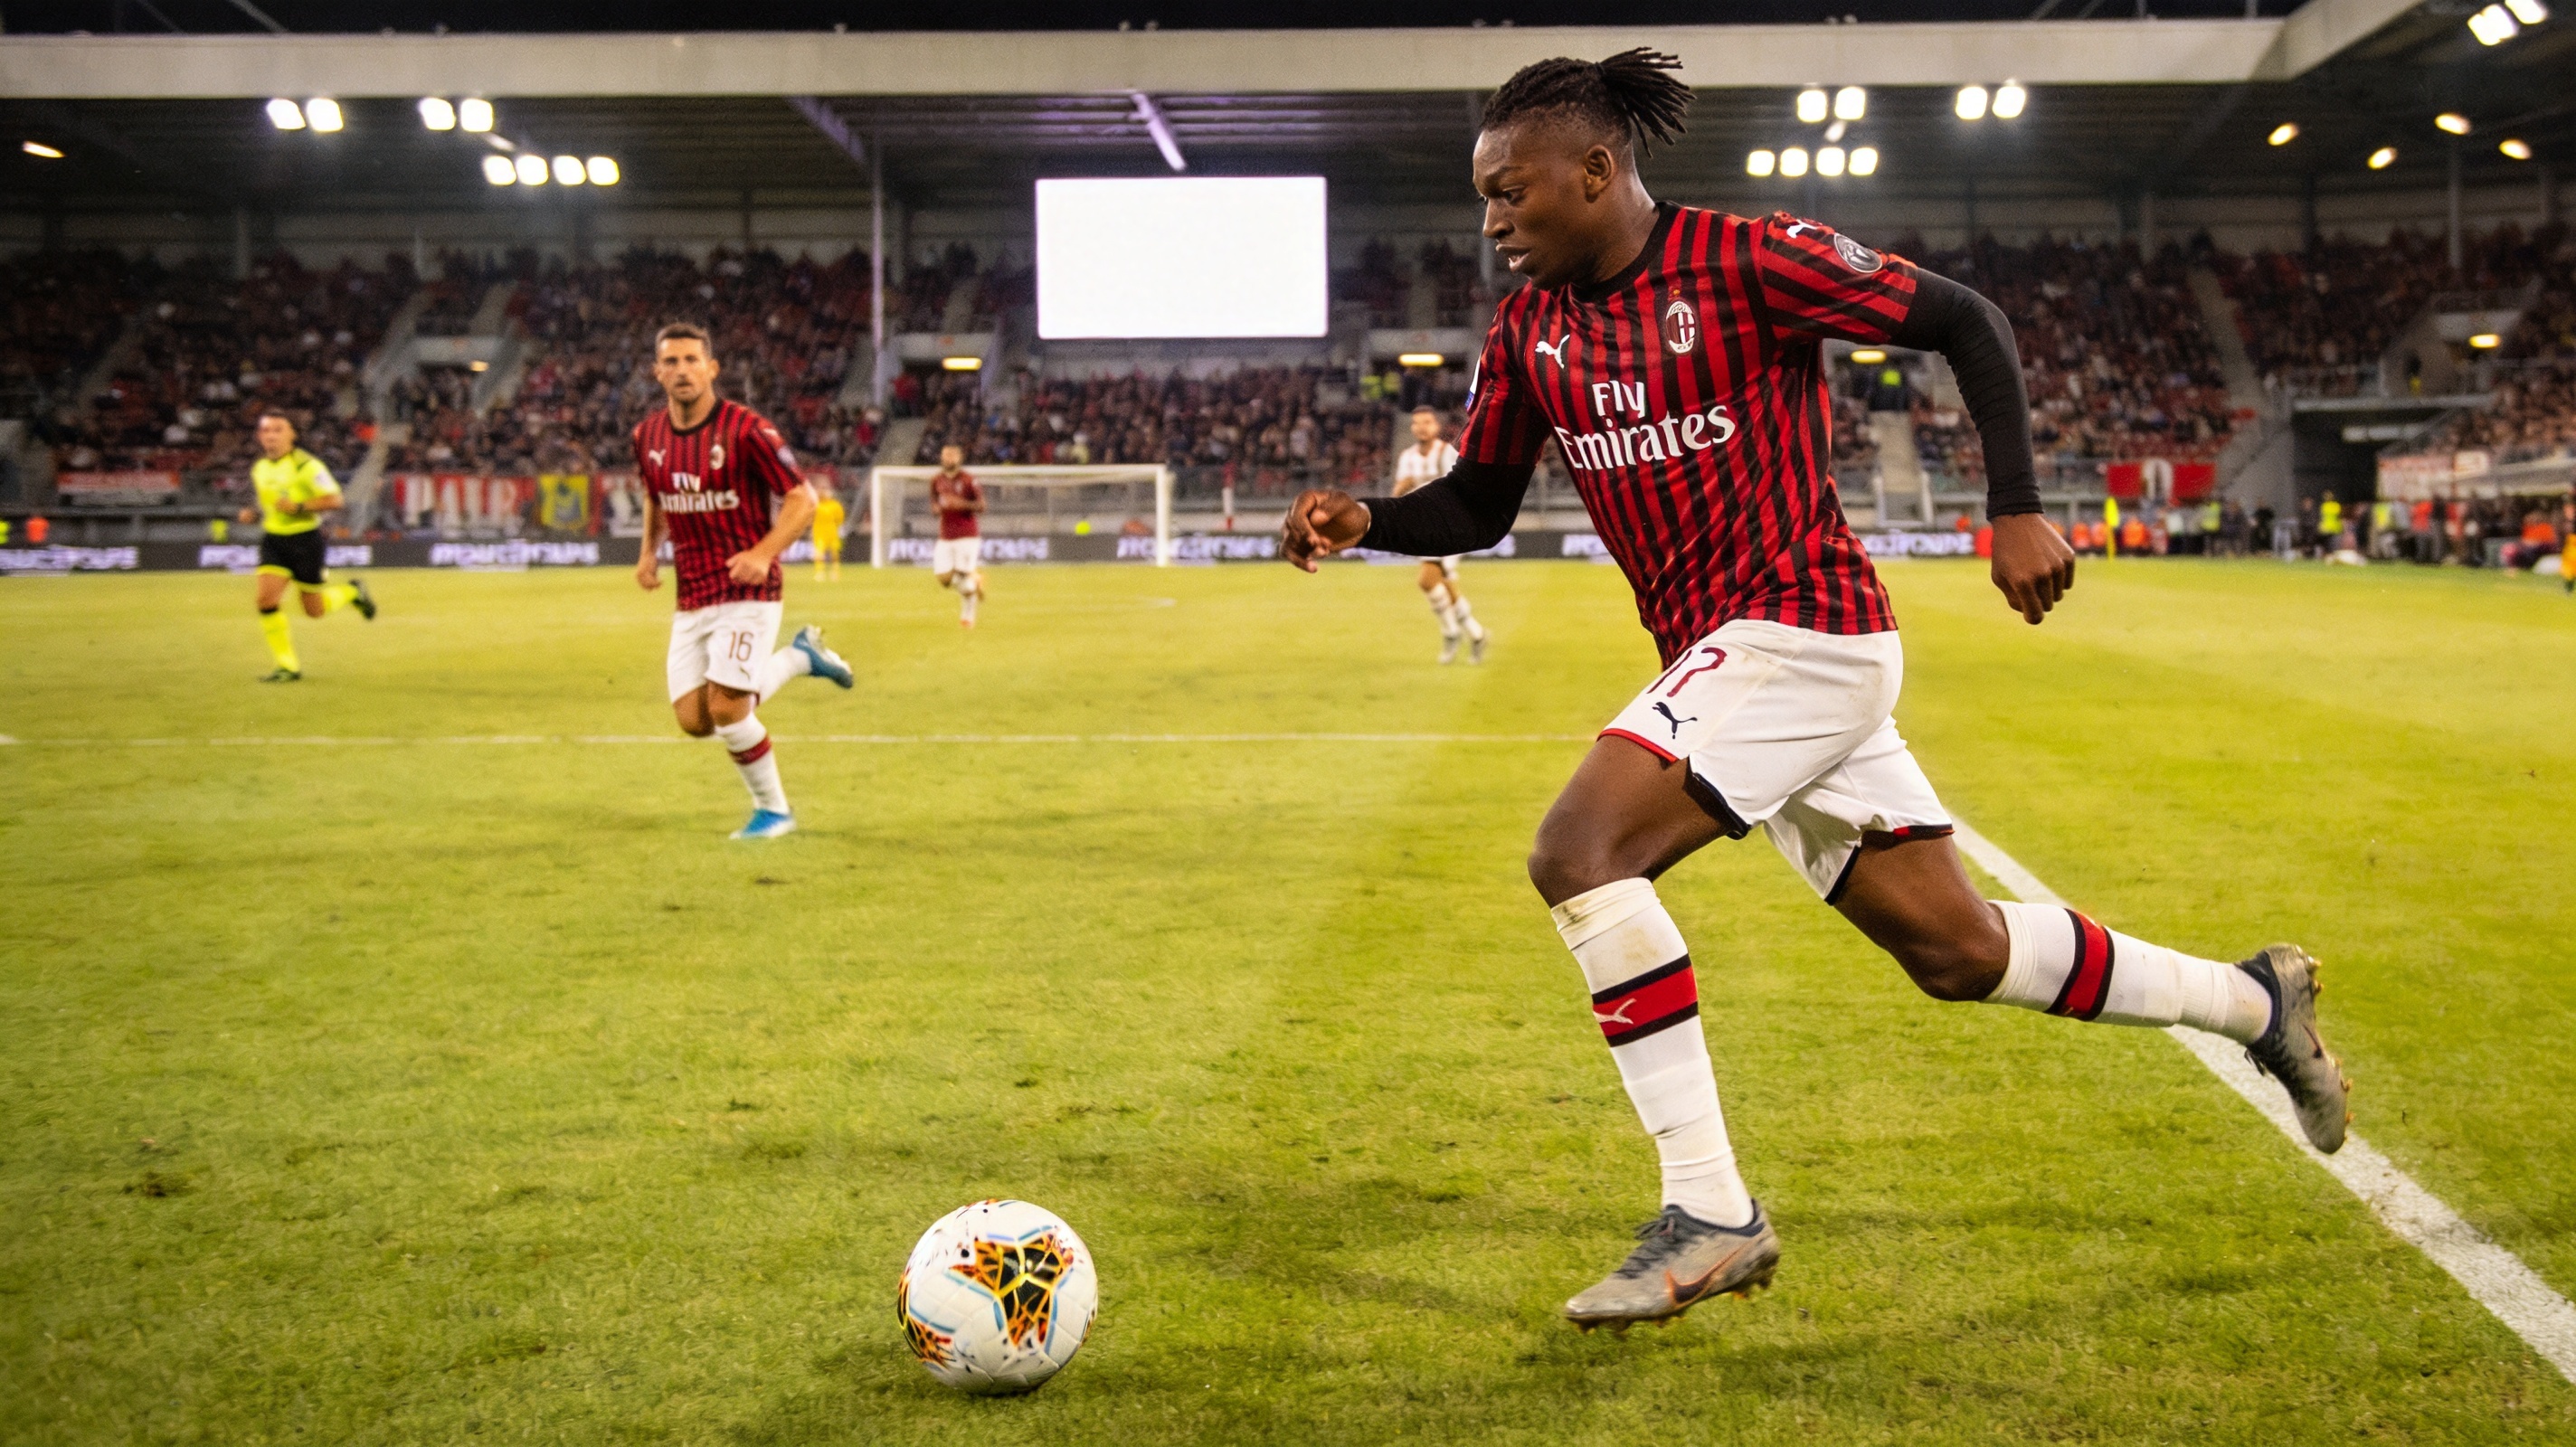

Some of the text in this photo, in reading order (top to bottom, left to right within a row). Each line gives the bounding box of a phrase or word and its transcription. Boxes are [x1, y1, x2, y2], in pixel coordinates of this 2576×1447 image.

[1592, 380, 1645, 419] Fly
[1554, 405, 1736, 470] Emirates
[729, 631, 754, 662] 16
[1646, 647, 1728, 698] 17
